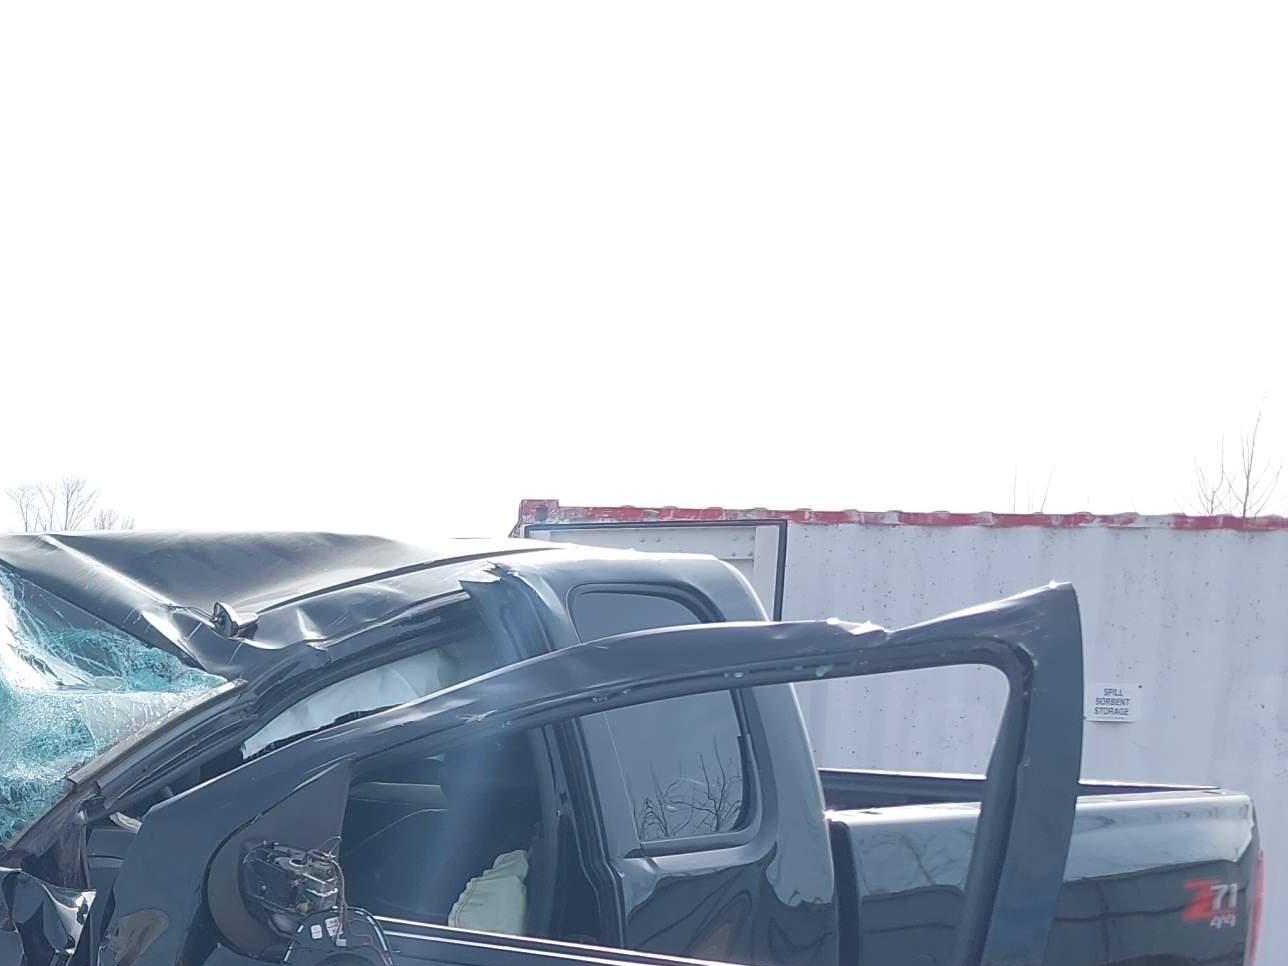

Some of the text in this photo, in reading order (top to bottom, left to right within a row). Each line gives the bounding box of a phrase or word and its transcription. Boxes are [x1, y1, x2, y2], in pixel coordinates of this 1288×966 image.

[1103, 688, 1123, 696] SPILL
[1095, 697, 1130, 706] SORBENT
[1094, 707, 1129, 715] STORAGE
[1182, 880, 1238, 921] Z71
